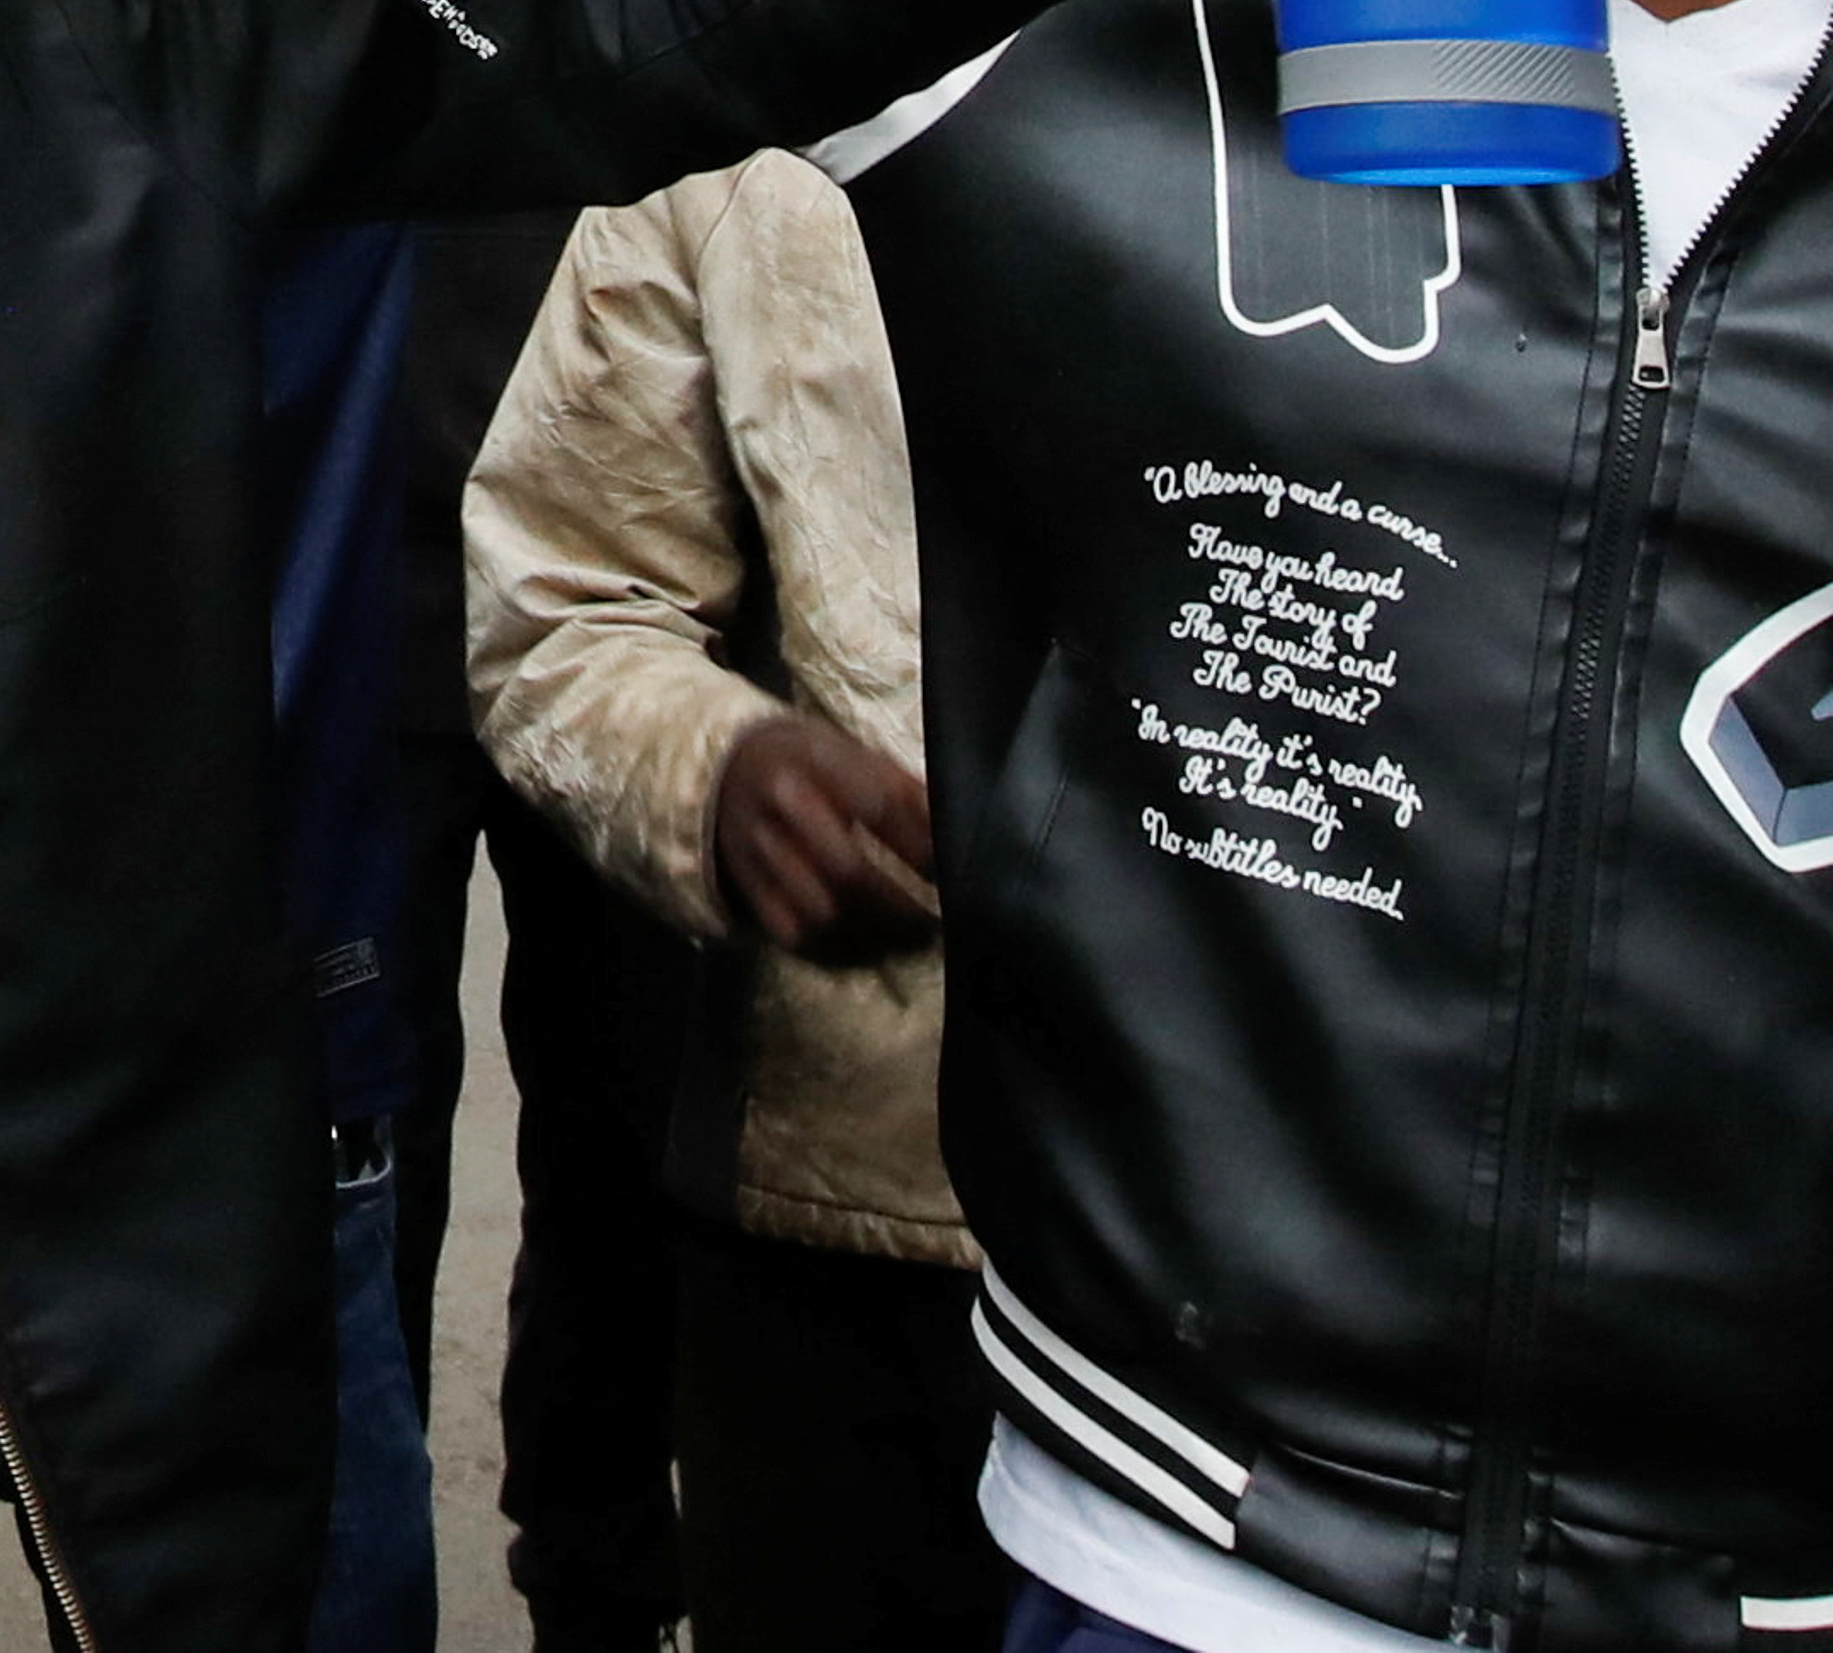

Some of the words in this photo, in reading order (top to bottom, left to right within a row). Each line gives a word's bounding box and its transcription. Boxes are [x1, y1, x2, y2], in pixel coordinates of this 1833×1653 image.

[1184, 459, 1285, 519] blessing
[1288, 480, 1343, 515] and
[1340, 498, 1363, 521] a
[1188, 522, 1265, 570] Have
[1260, 550, 1315, 593] you
[1315, 551, 1405, 601] heard
[1169, 602, 1228, 645] The
[1339, 649, 1398, 688] and
[1209, 567, 1264, 612] The
[1268, 583, 1337, 649] story
[1342, 599, 1377, 651] of
[1193, 649, 1253, 695] The
[1258, 663, 1382, 726] Purist?
[1172, 716, 1273, 784] reality
[1141, 806, 1183, 855] No
[1183, 827, 1301, 889] subtitles
